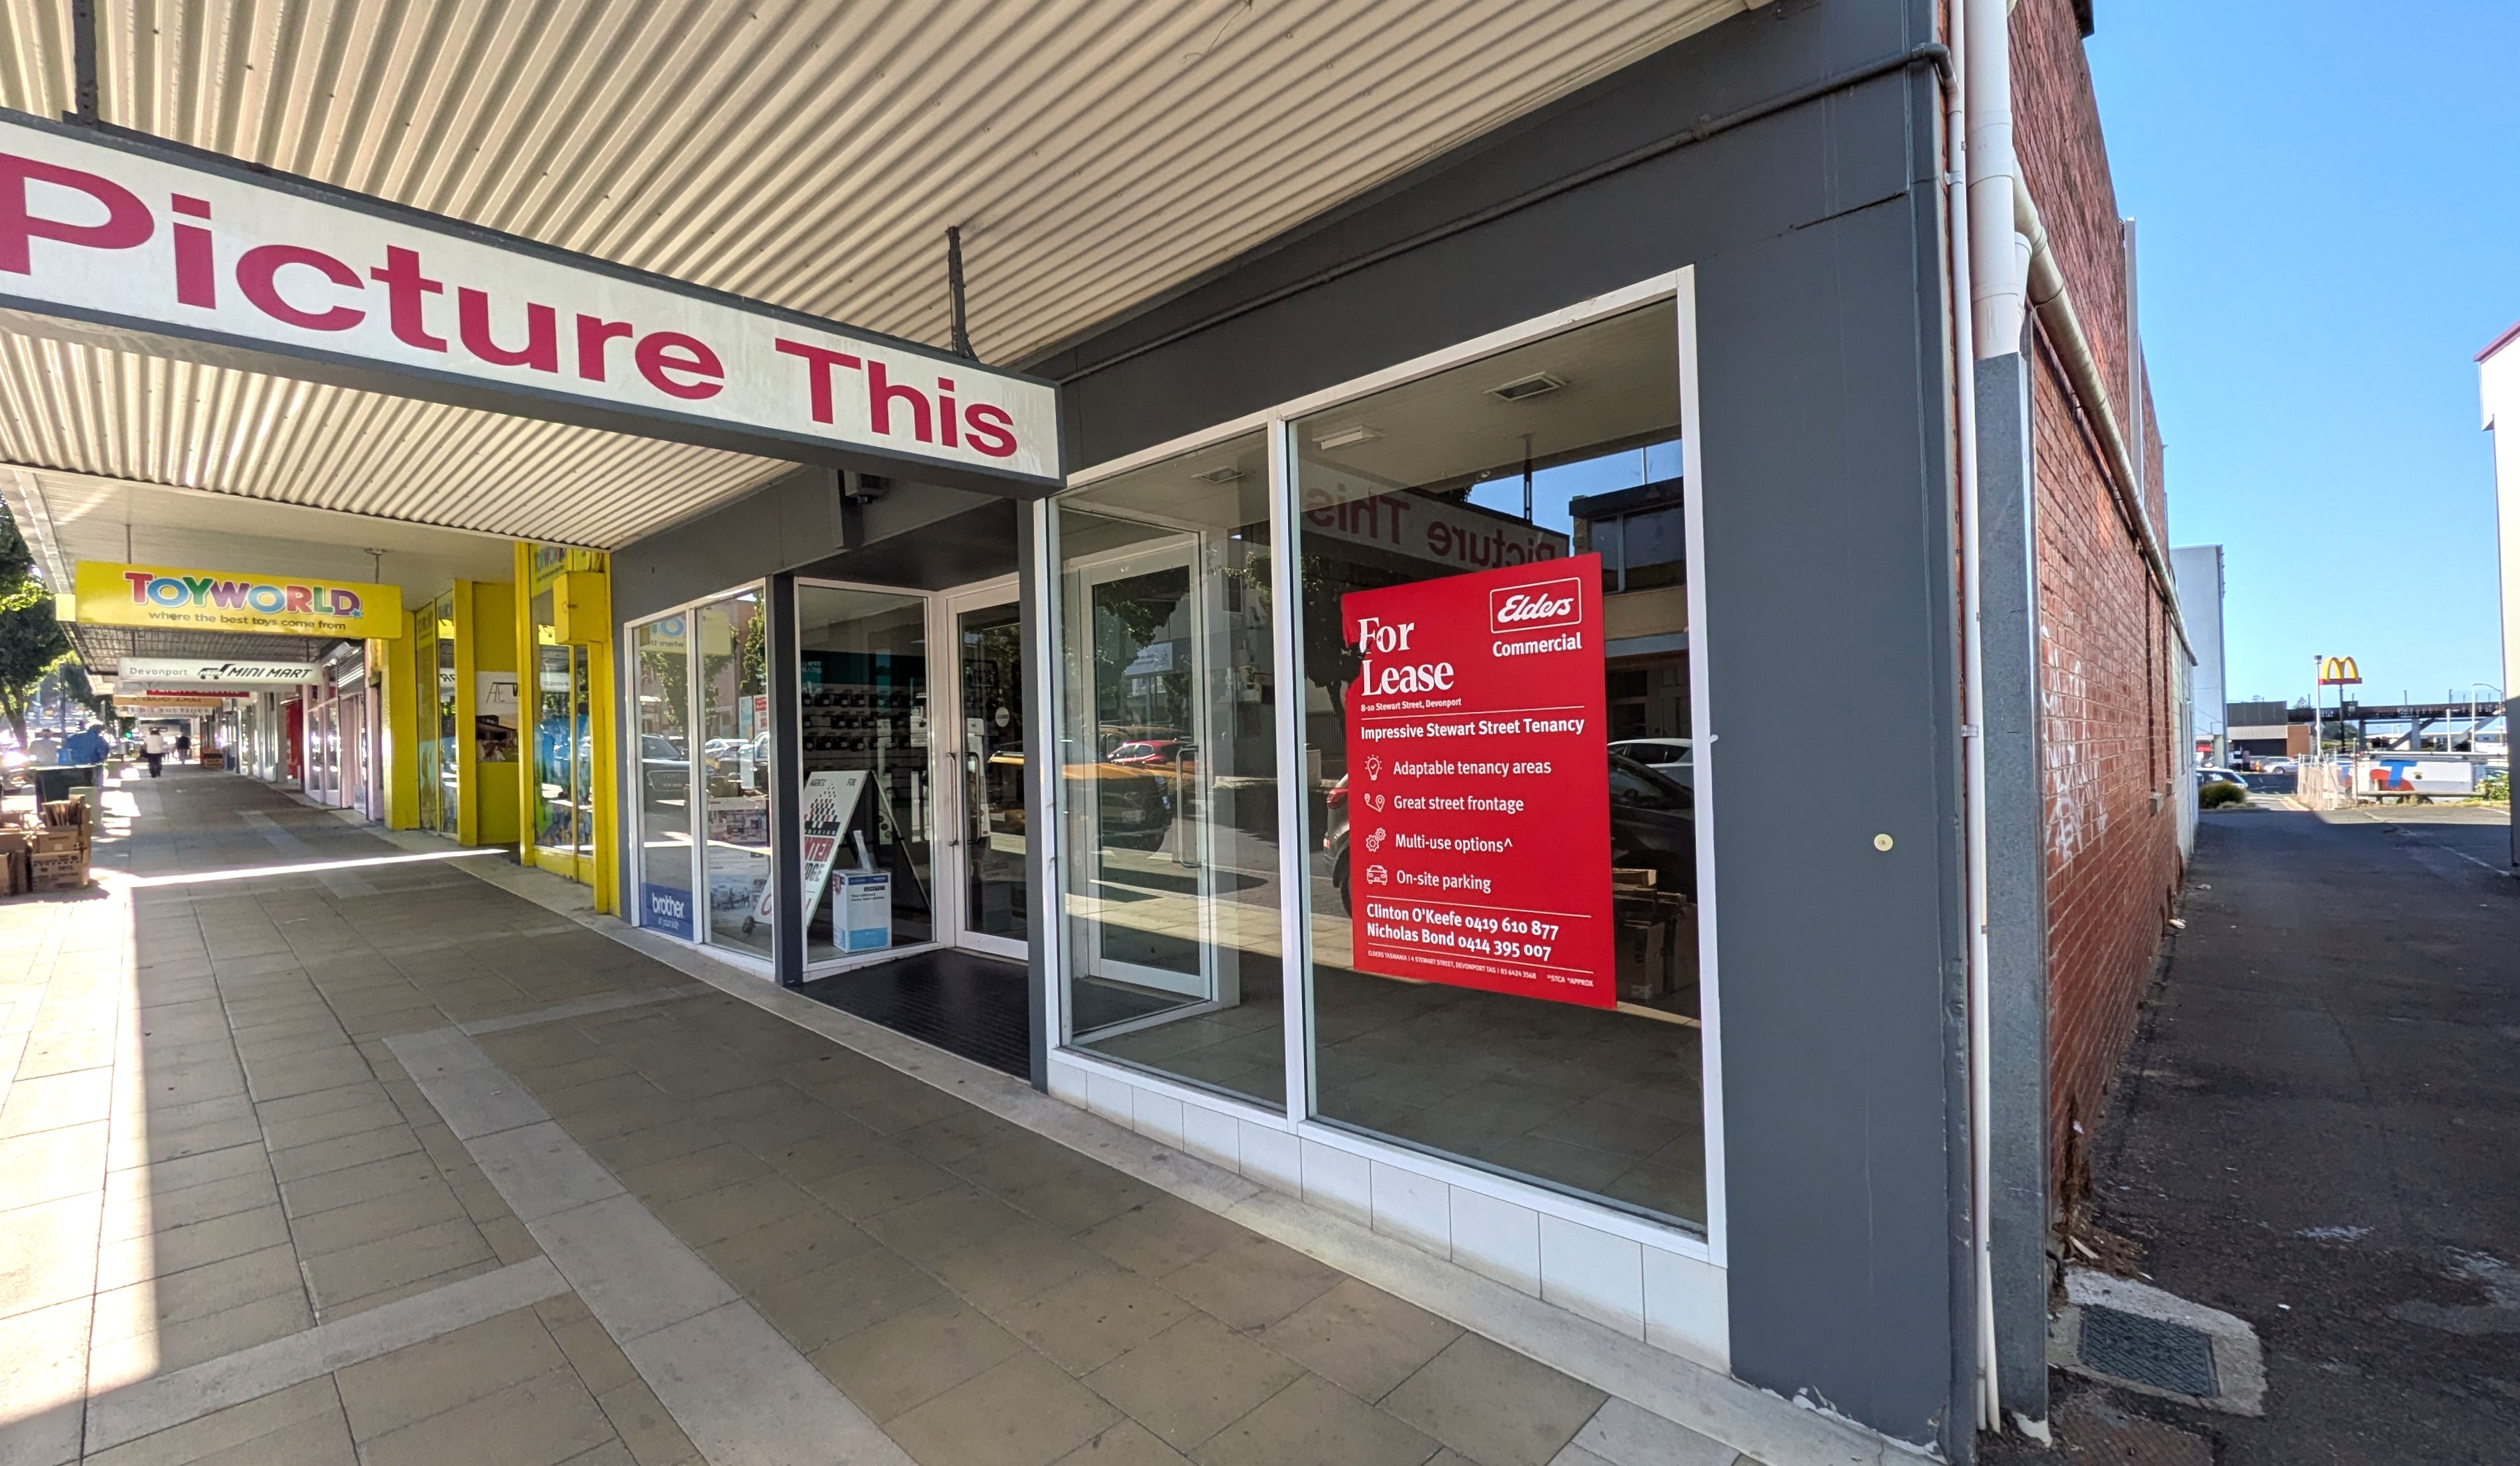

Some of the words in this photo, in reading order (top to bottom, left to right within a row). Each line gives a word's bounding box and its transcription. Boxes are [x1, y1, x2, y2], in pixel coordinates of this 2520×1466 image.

[0, 153, 724, 400] Picture
[775, 338, 1018, 457] This
[125, 571, 362, 618] TOYWORLD
[148, 611, 191, 621] where
[194, 613, 217, 622] the
[220, 615, 248, 624] best
[252, 618, 278, 627] toys
[318, 620, 346, 629] from
[1496, 592, 1574, 624] Elders
[1358, 616, 1415, 655] For
[1492, 632, 1582, 657] Commercial
[130, 667, 188, 676] Devonport
[227, 667, 264, 677] MINI
[265, 668, 313, 678] MART
[1361, 660, 1454, 697] Lease
[1361, 704, 1375, 712] 8-10
[1375, 702, 1401, 711] Stewart
[1401, 700, 1424, 710] Street,
[1425, 697, 1461, 709] Devonport
[1361, 723, 1424, 742] Impressive
[1427, 721, 1475, 737] Stewart
[1478, 719, 1520, 735] Street
[1522, 718, 1585, 735] Tenancy
[1393, 760, 1454, 778] Adaptable
[1457, 762, 1509, 777] tenancy
[1513, 761, 1552, 774] areas
[847, 778, 857, 787] FOR
[1394, 795, 1426, 810] Great
[1429, 796, 1465, 810] street
[1468, 795, 1524, 814] frontage
[1395, 833, 1451, 850] Multi-use
[1454, 837, 1513, 854] options^
[1396, 869, 1440, 886] On-site
[1443, 874, 1492, 894] parking
[651, 892, 685, 919] brother
[1366, 903, 1409, 921] Clinton
[1412, 908, 1462, 927] O'Keefe
[1465, 916, 1499, 934] 0419
[1501, 917, 1528, 934] 610
[1531, 920, 1559, 941] 877
[1367, 923, 1419, 942] Nicholas
[1422, 928, 1454, 947] Bond
[1458, 936, 1491, 954] 0414
[1493, 940, 1520, 958] 395
[1523, 944, 1552, 962] 007
[1368, 950, 1385, 958] ELDERS
[1385, 952, 1408, 961] TASMANIA
[1415, 956, 1436, 965] STEWART
[1455, 962, 1485, 972] DEVONPORT
[1508, 969, 1522, 977] 6424
[1523, 971, 1536, 979] 3568
